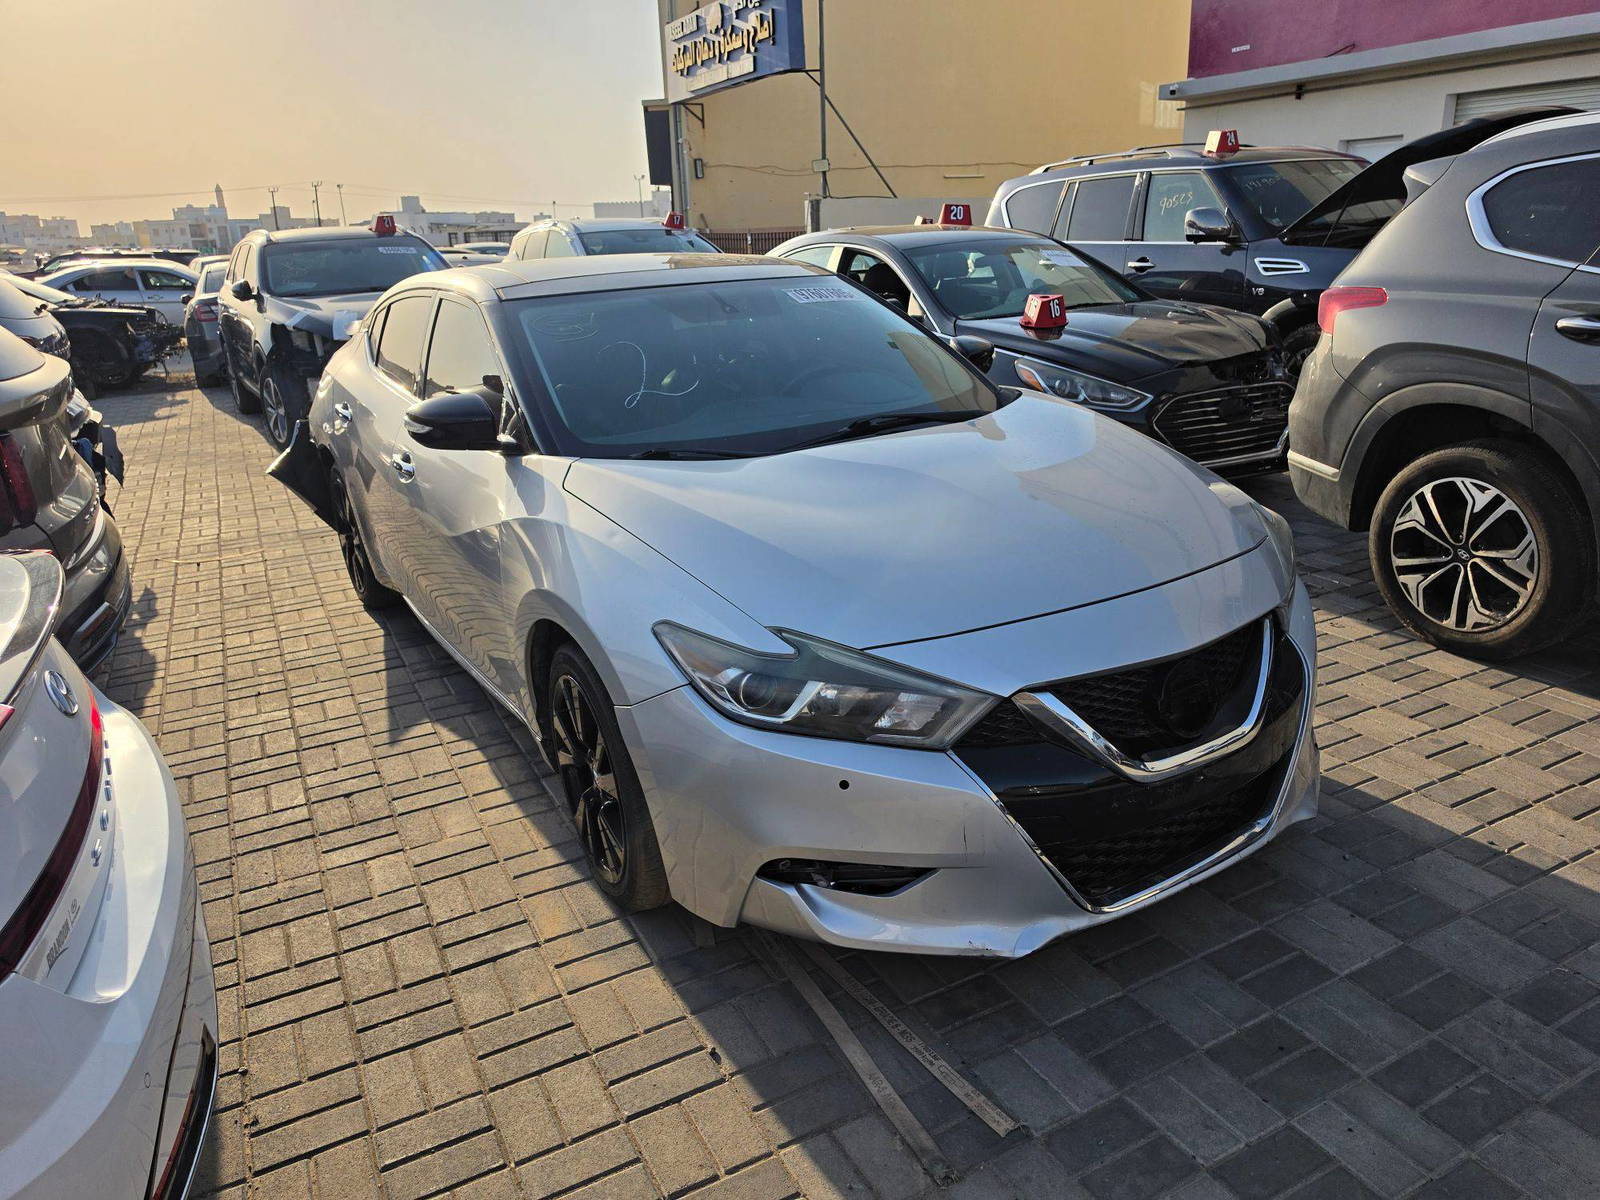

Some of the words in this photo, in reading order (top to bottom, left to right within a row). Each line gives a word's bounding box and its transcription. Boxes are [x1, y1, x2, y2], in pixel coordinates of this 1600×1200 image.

[673, 215, 681, 225] 17
[950, 205, 964, 221] 20
[1049, 298, 1061, 319] 16
